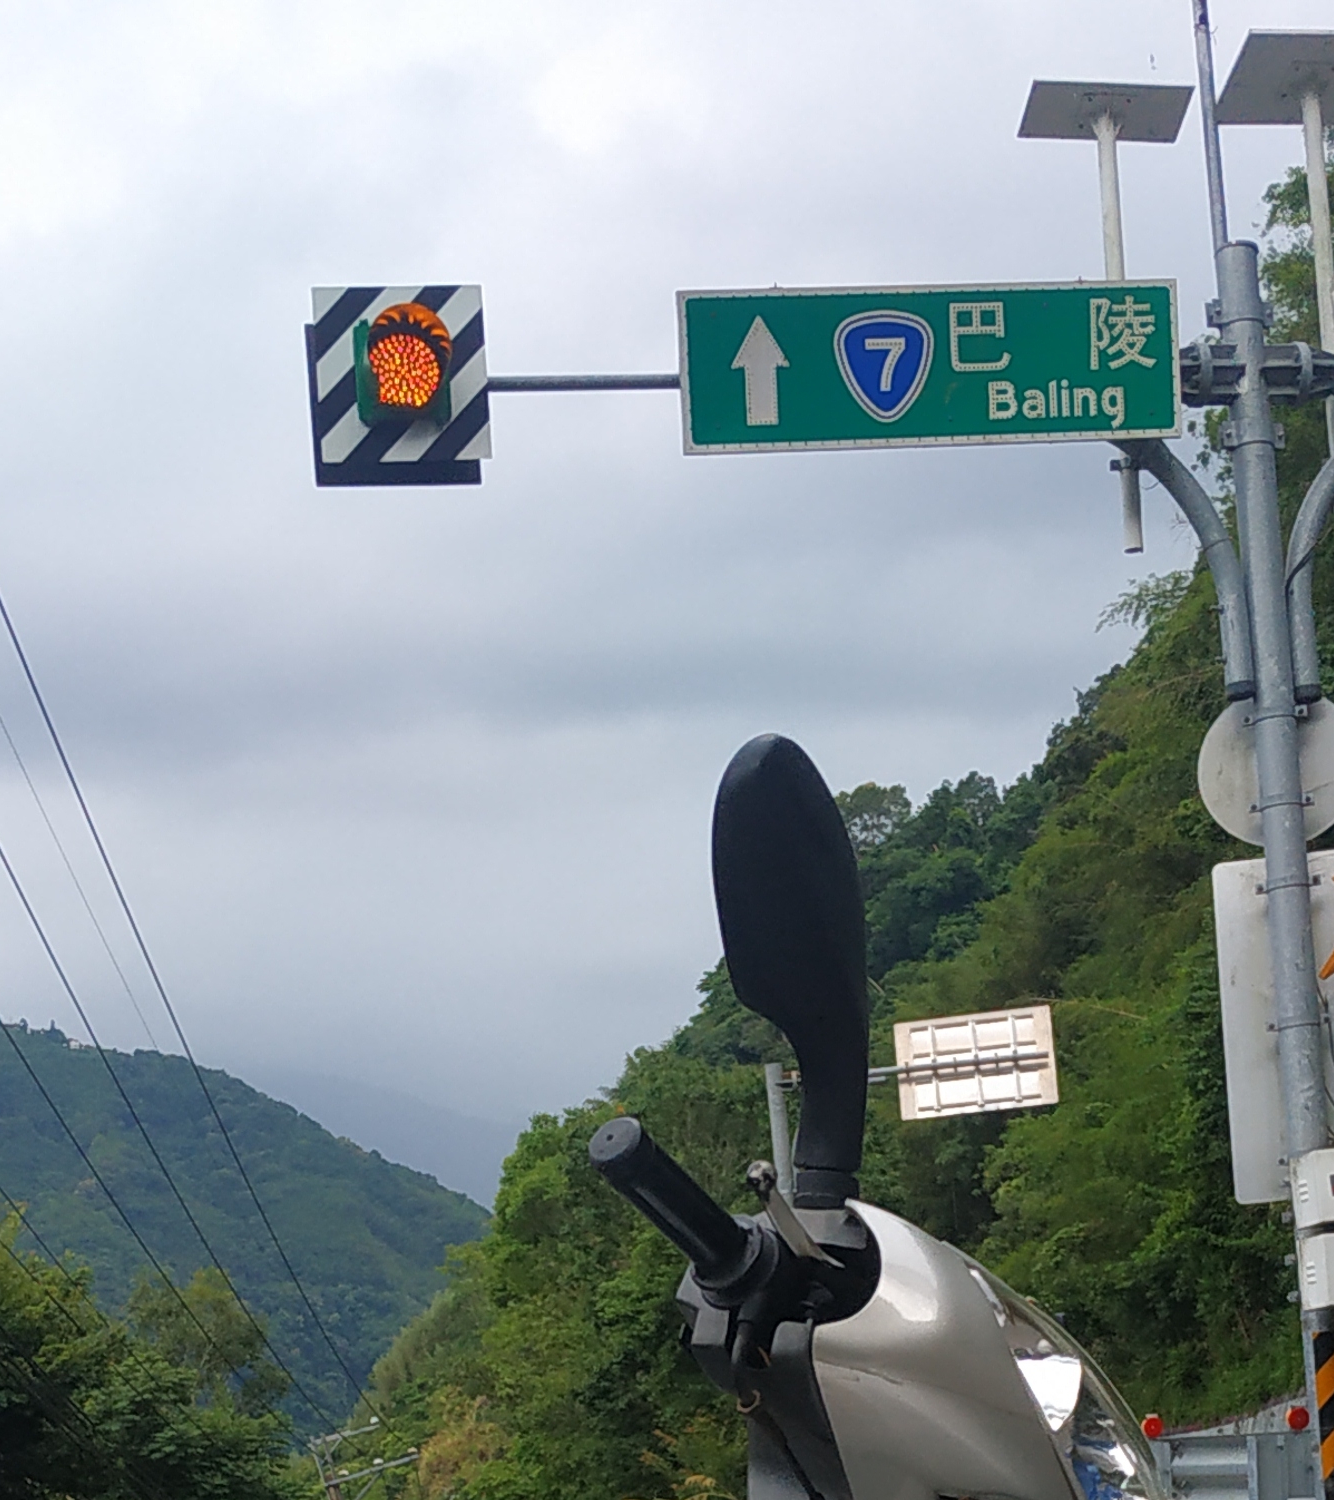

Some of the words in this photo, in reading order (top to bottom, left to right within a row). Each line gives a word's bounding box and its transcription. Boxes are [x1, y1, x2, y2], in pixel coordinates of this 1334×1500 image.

[948, 295, 1158, 373] 巴陵
[864, 336, 907, 393] 7
[987, 378, 1126, 429] Baling
